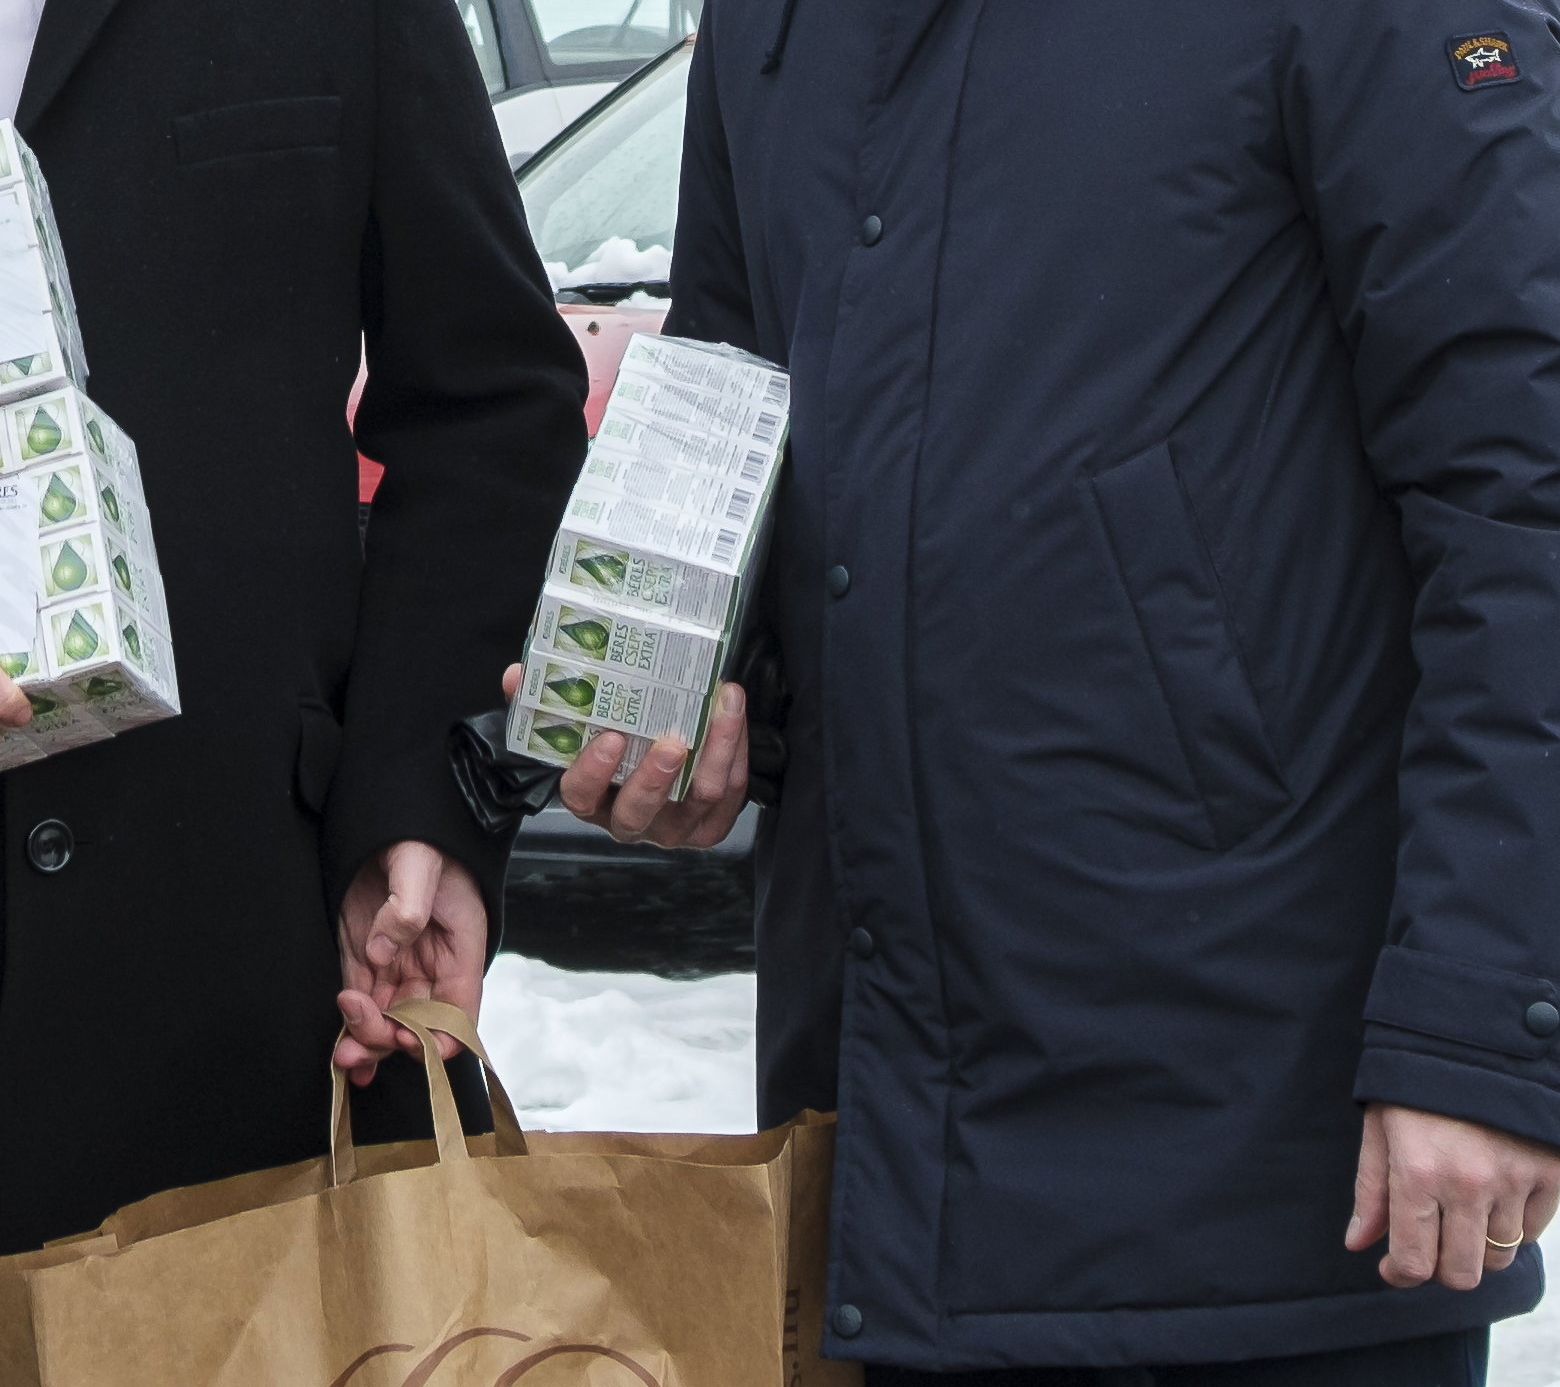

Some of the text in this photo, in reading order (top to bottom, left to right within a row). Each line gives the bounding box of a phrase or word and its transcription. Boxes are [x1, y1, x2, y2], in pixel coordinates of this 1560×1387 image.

[610, 623, 629, 663] BÉRES
[624, 627, 642, 667] CSEPP
[639, 631, 657, 671] EXTRA
[596, 680, 615, 719] BÉRES
[611, 684, 628, 722] CSEPP
[624, 688, 642, 725] EXTRA
